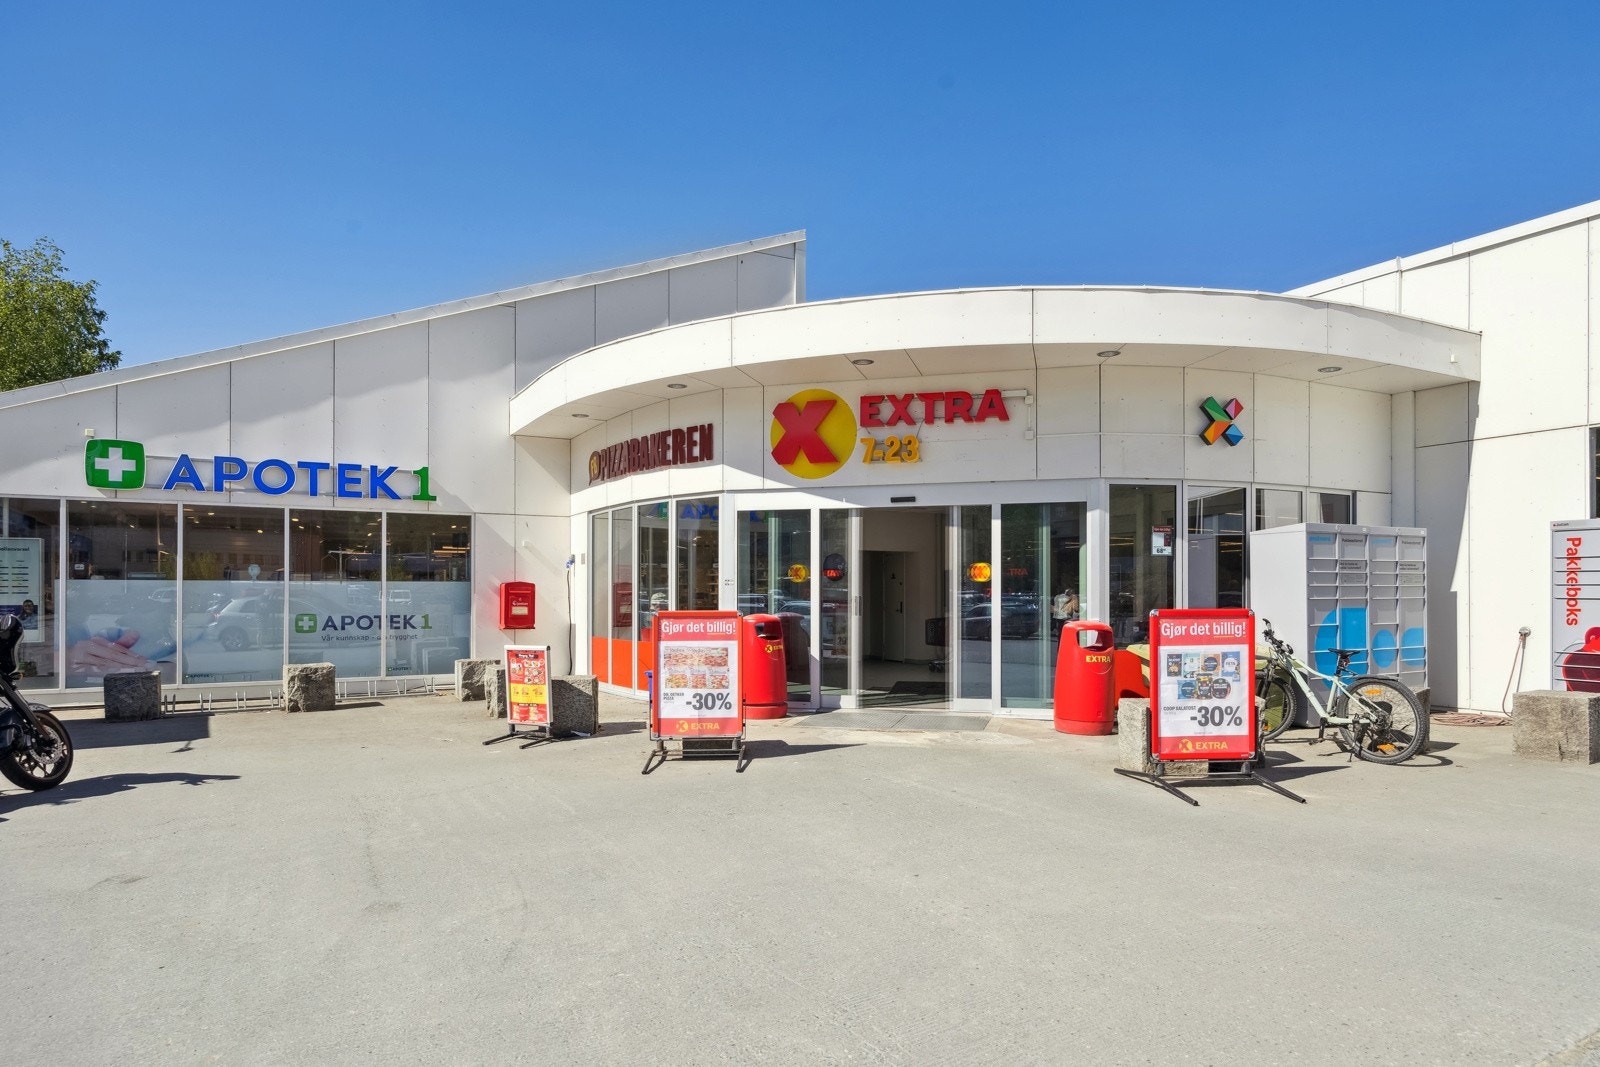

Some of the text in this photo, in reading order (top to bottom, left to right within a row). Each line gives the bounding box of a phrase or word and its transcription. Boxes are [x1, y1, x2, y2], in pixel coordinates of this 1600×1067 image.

[860, 389, 1010, 427] EXTRA
[600, 423, 713, 480] PIZZABAKEREN
[860, 435, 919, 464] 7-23
[162, 454, 438, 501] APOTEK 1
[1566, 537, 1582, 626] Pakkeboks
[321, 613, 432, 631] APOTEK 1
[662, 621, 736, 635] Gjør det billig!
[1161, 622, 1246, 638] Gjør det billig!
[686, 692, 732, 710] -30%
[1190, 706, 1242, 726] -30%
[1196, 742, 1228, 750] EXTRA
